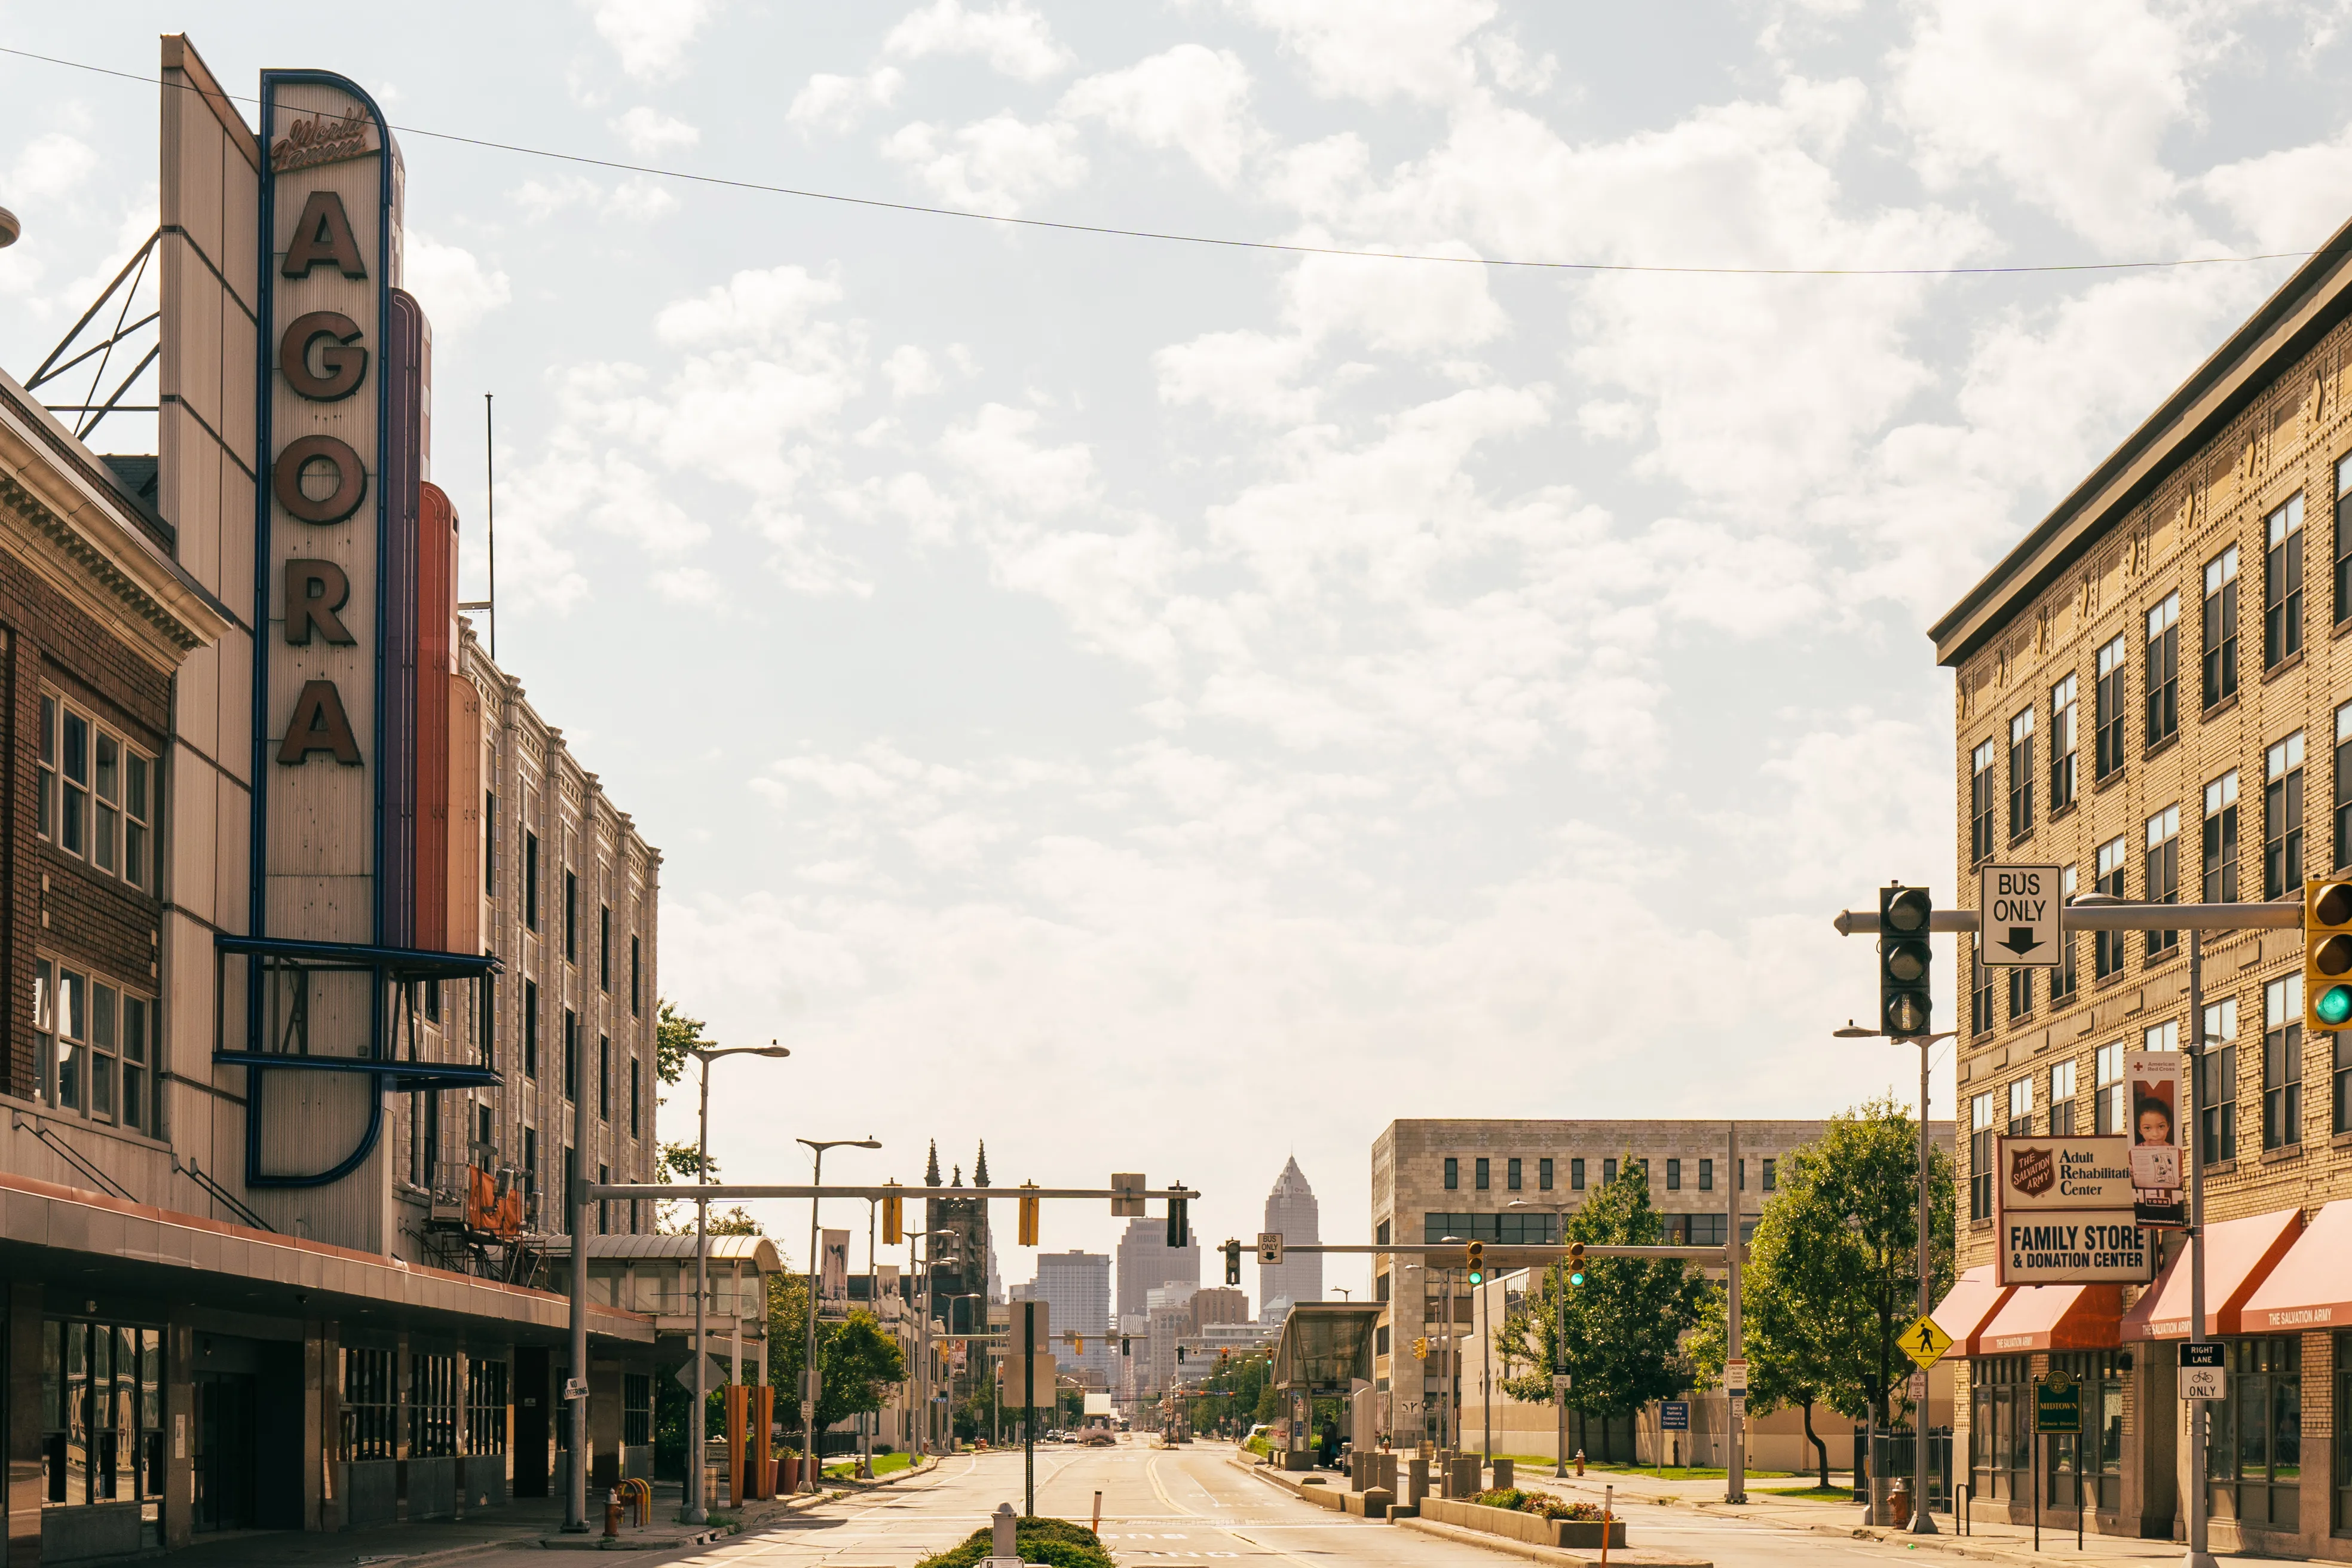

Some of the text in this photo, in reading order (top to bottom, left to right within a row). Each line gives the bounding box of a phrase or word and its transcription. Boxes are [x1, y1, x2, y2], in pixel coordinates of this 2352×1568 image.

[290, 103, 367, 149] World
[271, 134, 366, 172] Famous
[274, 191, 369, 766] AGORA
[1999, 874, 2040, 895] BUS
[1993, 899, 2047, 921] ONLY
[2019, 1153, 2036, 1168] THE
[2059, 1149, 2094, 1163] Adult
[2013, 1155, 2050, 1186] SALVATION
[2027, 1169, 2050, 1190] ARMY
[2060, 1165, 2132, 1180] Rehabilitati
[2060, 1180, 2102, 1196] Center
[2011, 1225, 2145, 1251] FAMILY STORE
[2013, 1252, 2143, 1268] & DONATION CENTER
[2269, 1308, 2332, 1326] THE SALVATION ARMY
[2142, 1324, 2151, 1336] THE
[2152, 1322, 2178, 1335] SALVATION
[2189, 1386, 2216, 1396] ONLY
